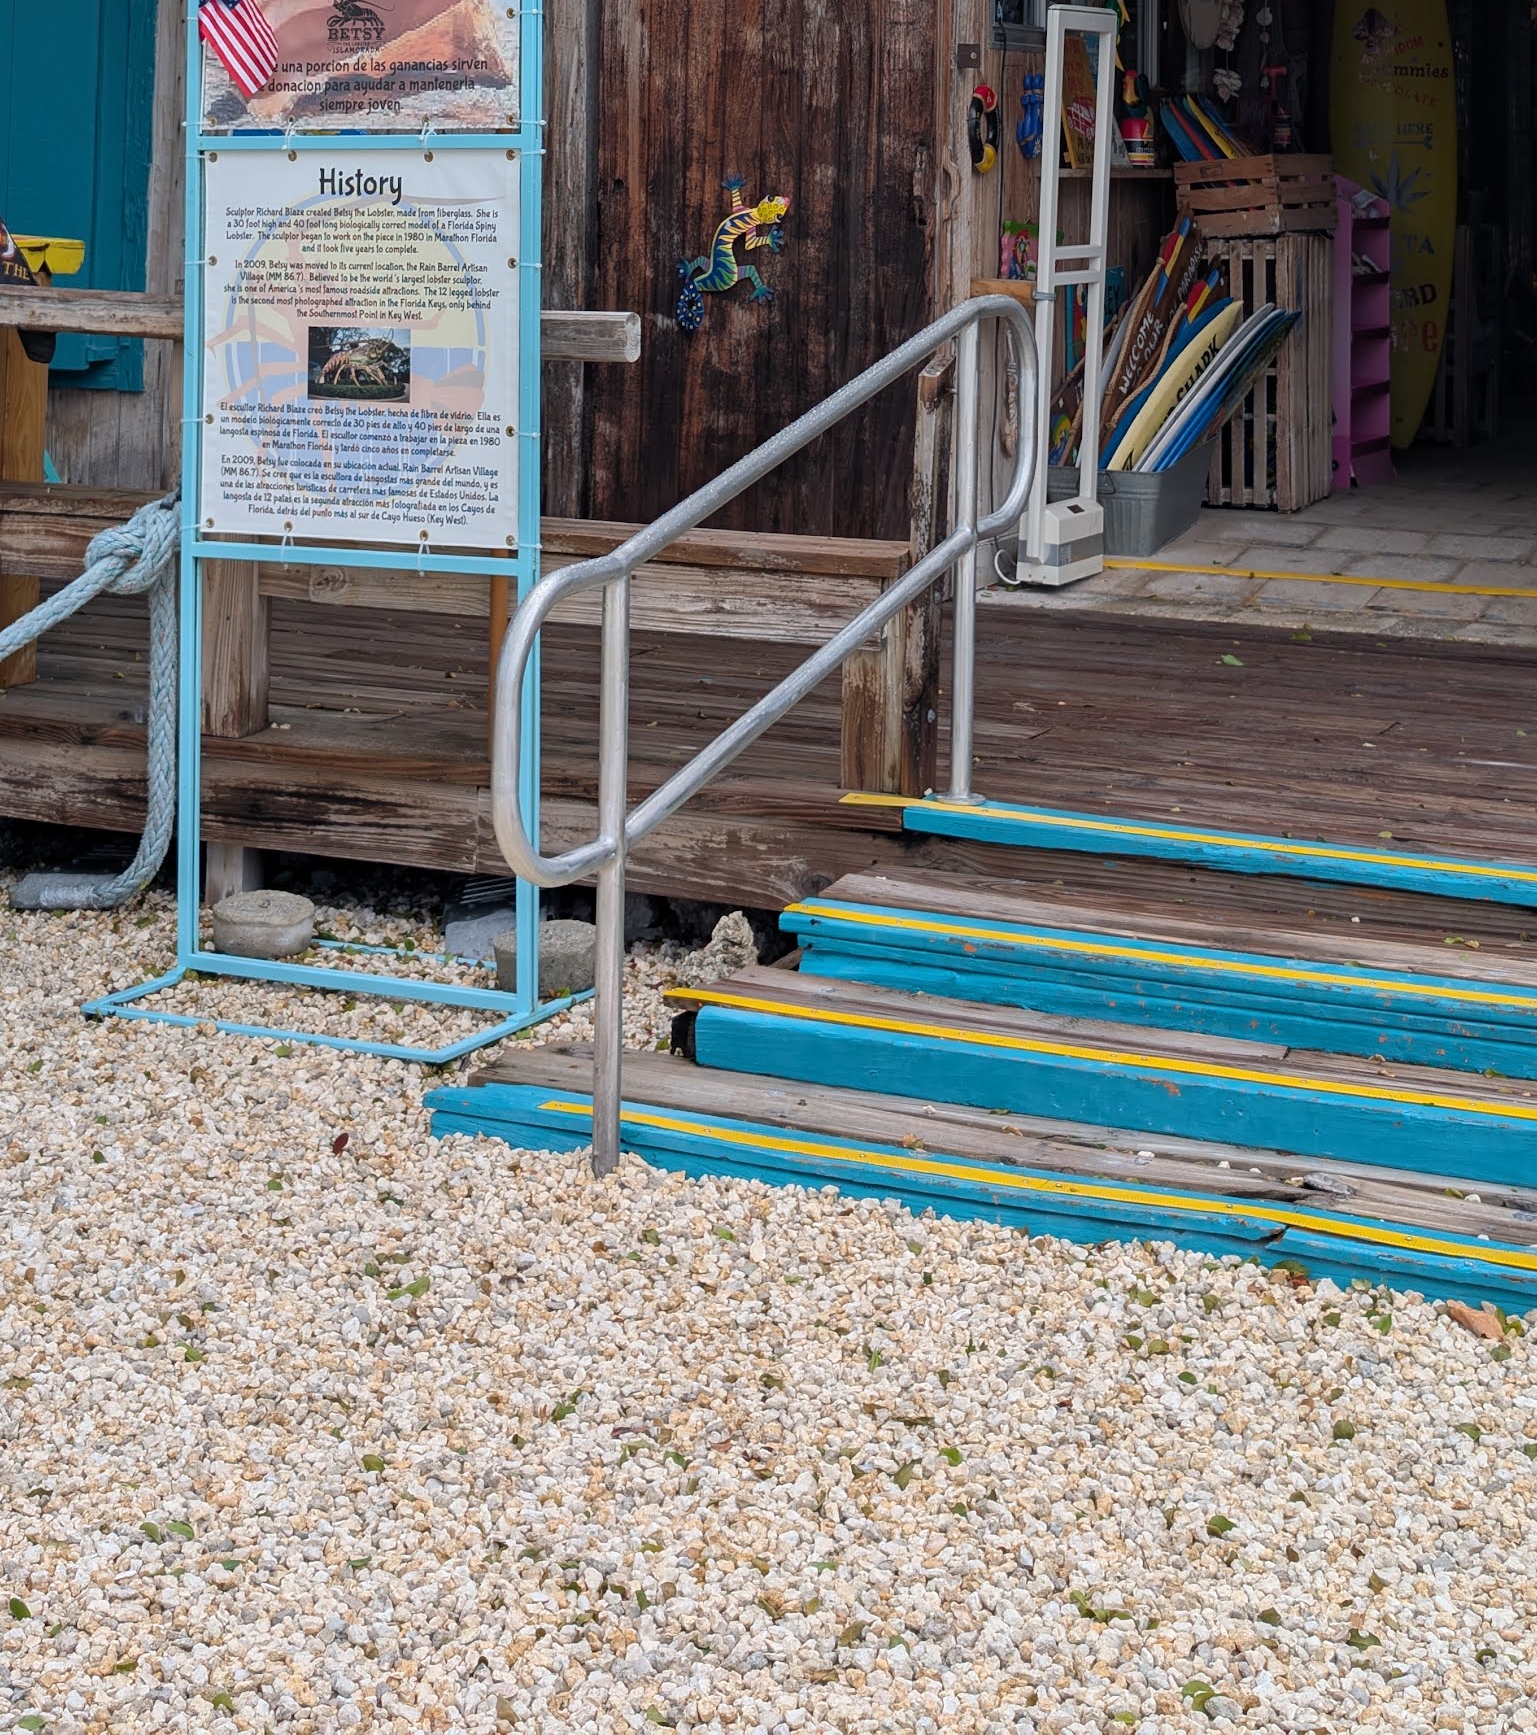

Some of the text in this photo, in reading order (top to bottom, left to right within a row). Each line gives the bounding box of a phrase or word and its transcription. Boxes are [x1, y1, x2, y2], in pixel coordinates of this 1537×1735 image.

[328, 27, 385, 42] BETSY
[282, 57, 488, 76] una porcion de las ganancias sirven
[268, 77, 475, 95] donacion para ayudar a mantenerla
[320, 98, 403, 115] siempre joven.
[319, 168, 402, 205] History
[1119, 309, 1154, 394] WELCOME
